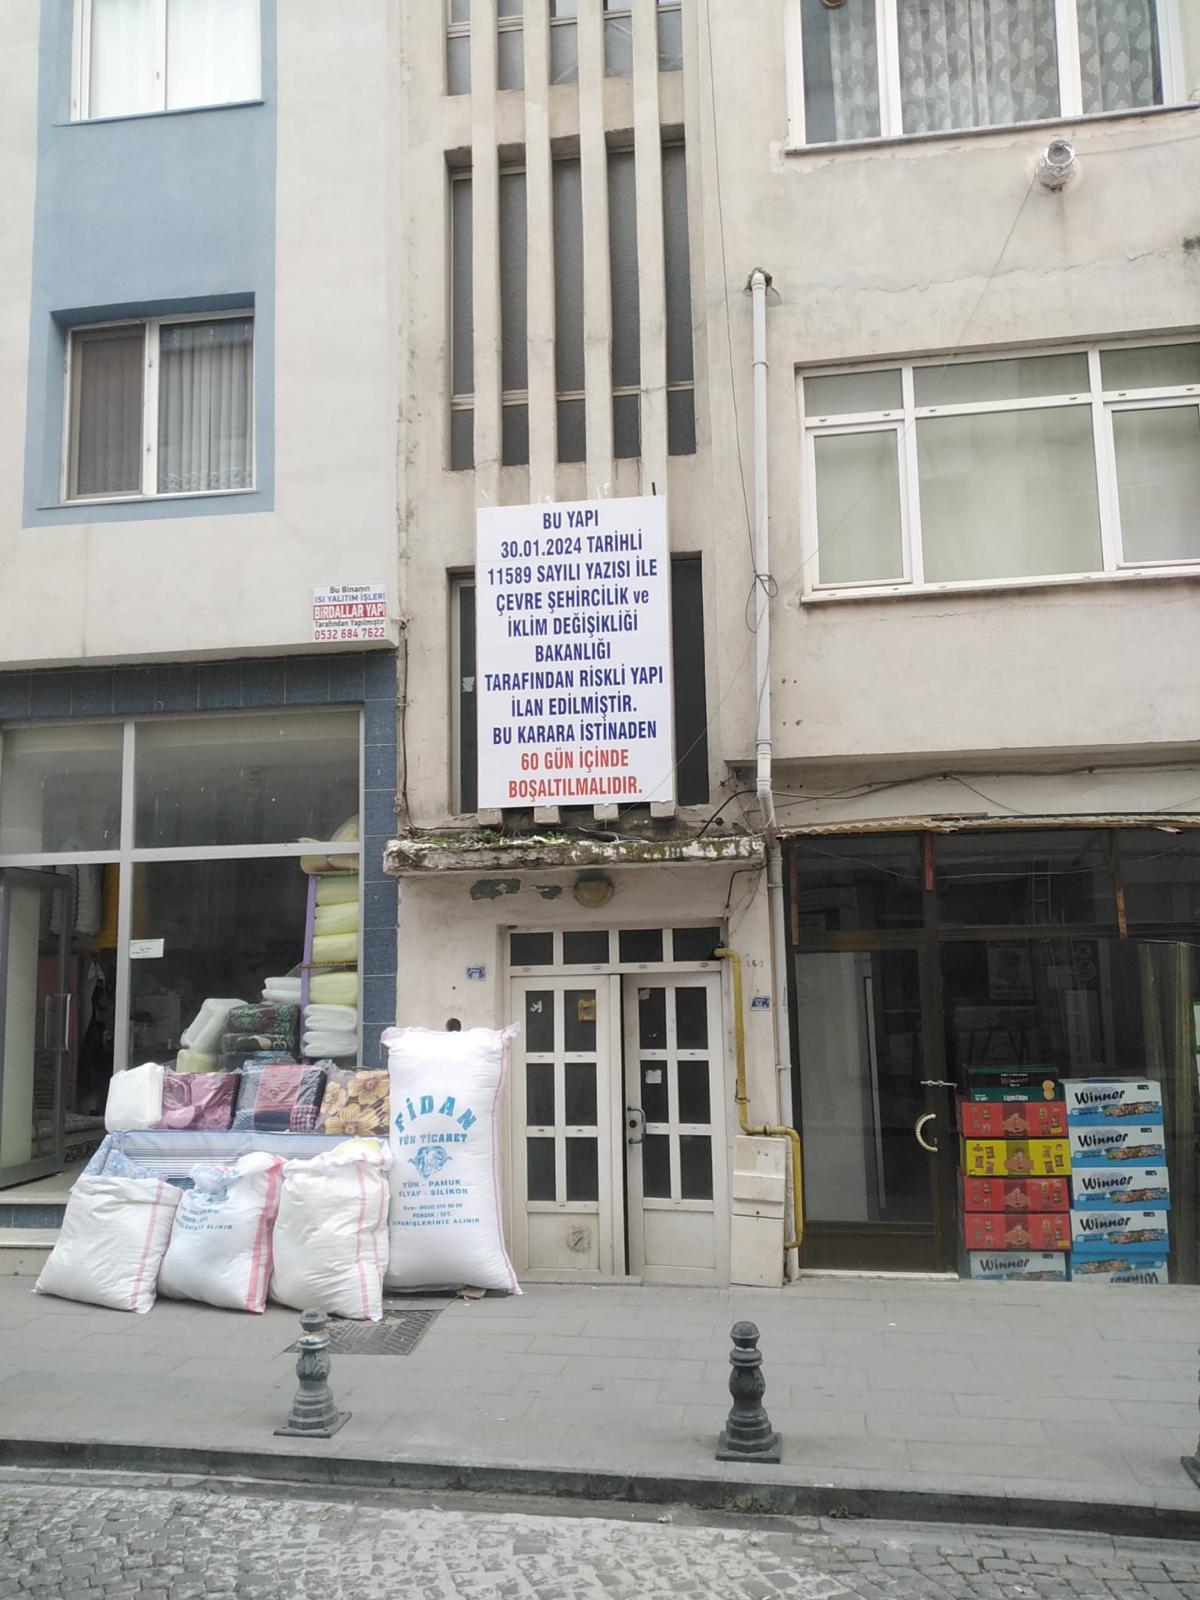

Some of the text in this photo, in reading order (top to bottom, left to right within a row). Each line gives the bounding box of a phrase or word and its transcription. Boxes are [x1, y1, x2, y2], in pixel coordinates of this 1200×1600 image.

[543, 509, 598, 529] BU YAPI
[501, 528, 643, 558] 30.01.2024 TARİHLİ
[488, 556, 657, 585] 11589 SAYILI YAZISI İLE
[327, 594, 358, 603] YALITIM
[360, 592, 385, 602] İŞLERİ
[342, 585, 370, 593] Binanın
[496, 583, 649, 616] ÇEVRE ŞEHİRCİLİK ve
[364, 603, 385, 618] YAPI
[508, 609, 638, 638] İKLİM DEĞİŞİKLİĞİ
[314, 629, 338, 640] 0532
[361, 627, 385, 638] 7622
[535, 638, 611, 662] BAKANLIĞI
[484, 664, 663, 692] TARAFINDAN RİSKLİ YAPI
[511, 691, 637, 718] İLAN EDİLMİŞTİR.
[493, 719, 657, 745] BU KARARA İSTİNADEN
[521, 746, 629, 773] 60 GÜN İÇİNDE
[509, 776, 643, 802] BOŞALTILMALIDIR.
[1075, 1090, 1125, 1105] Winner
[394, 1095, 477, 1133] FİDAN
[419, 1132, 468, 1144] TİCARET
[1078, 1132, 1128, 1147] Winner
[428, 1179, 462, 1187] PAMUK
[1082, 1176, 1133, 1190] Winner
[430, 1188, 468, 1196] SİLİKON
[1080, 1217, 1131, 1231] Winner
[979, 1258, 1030, 1272] Winner
